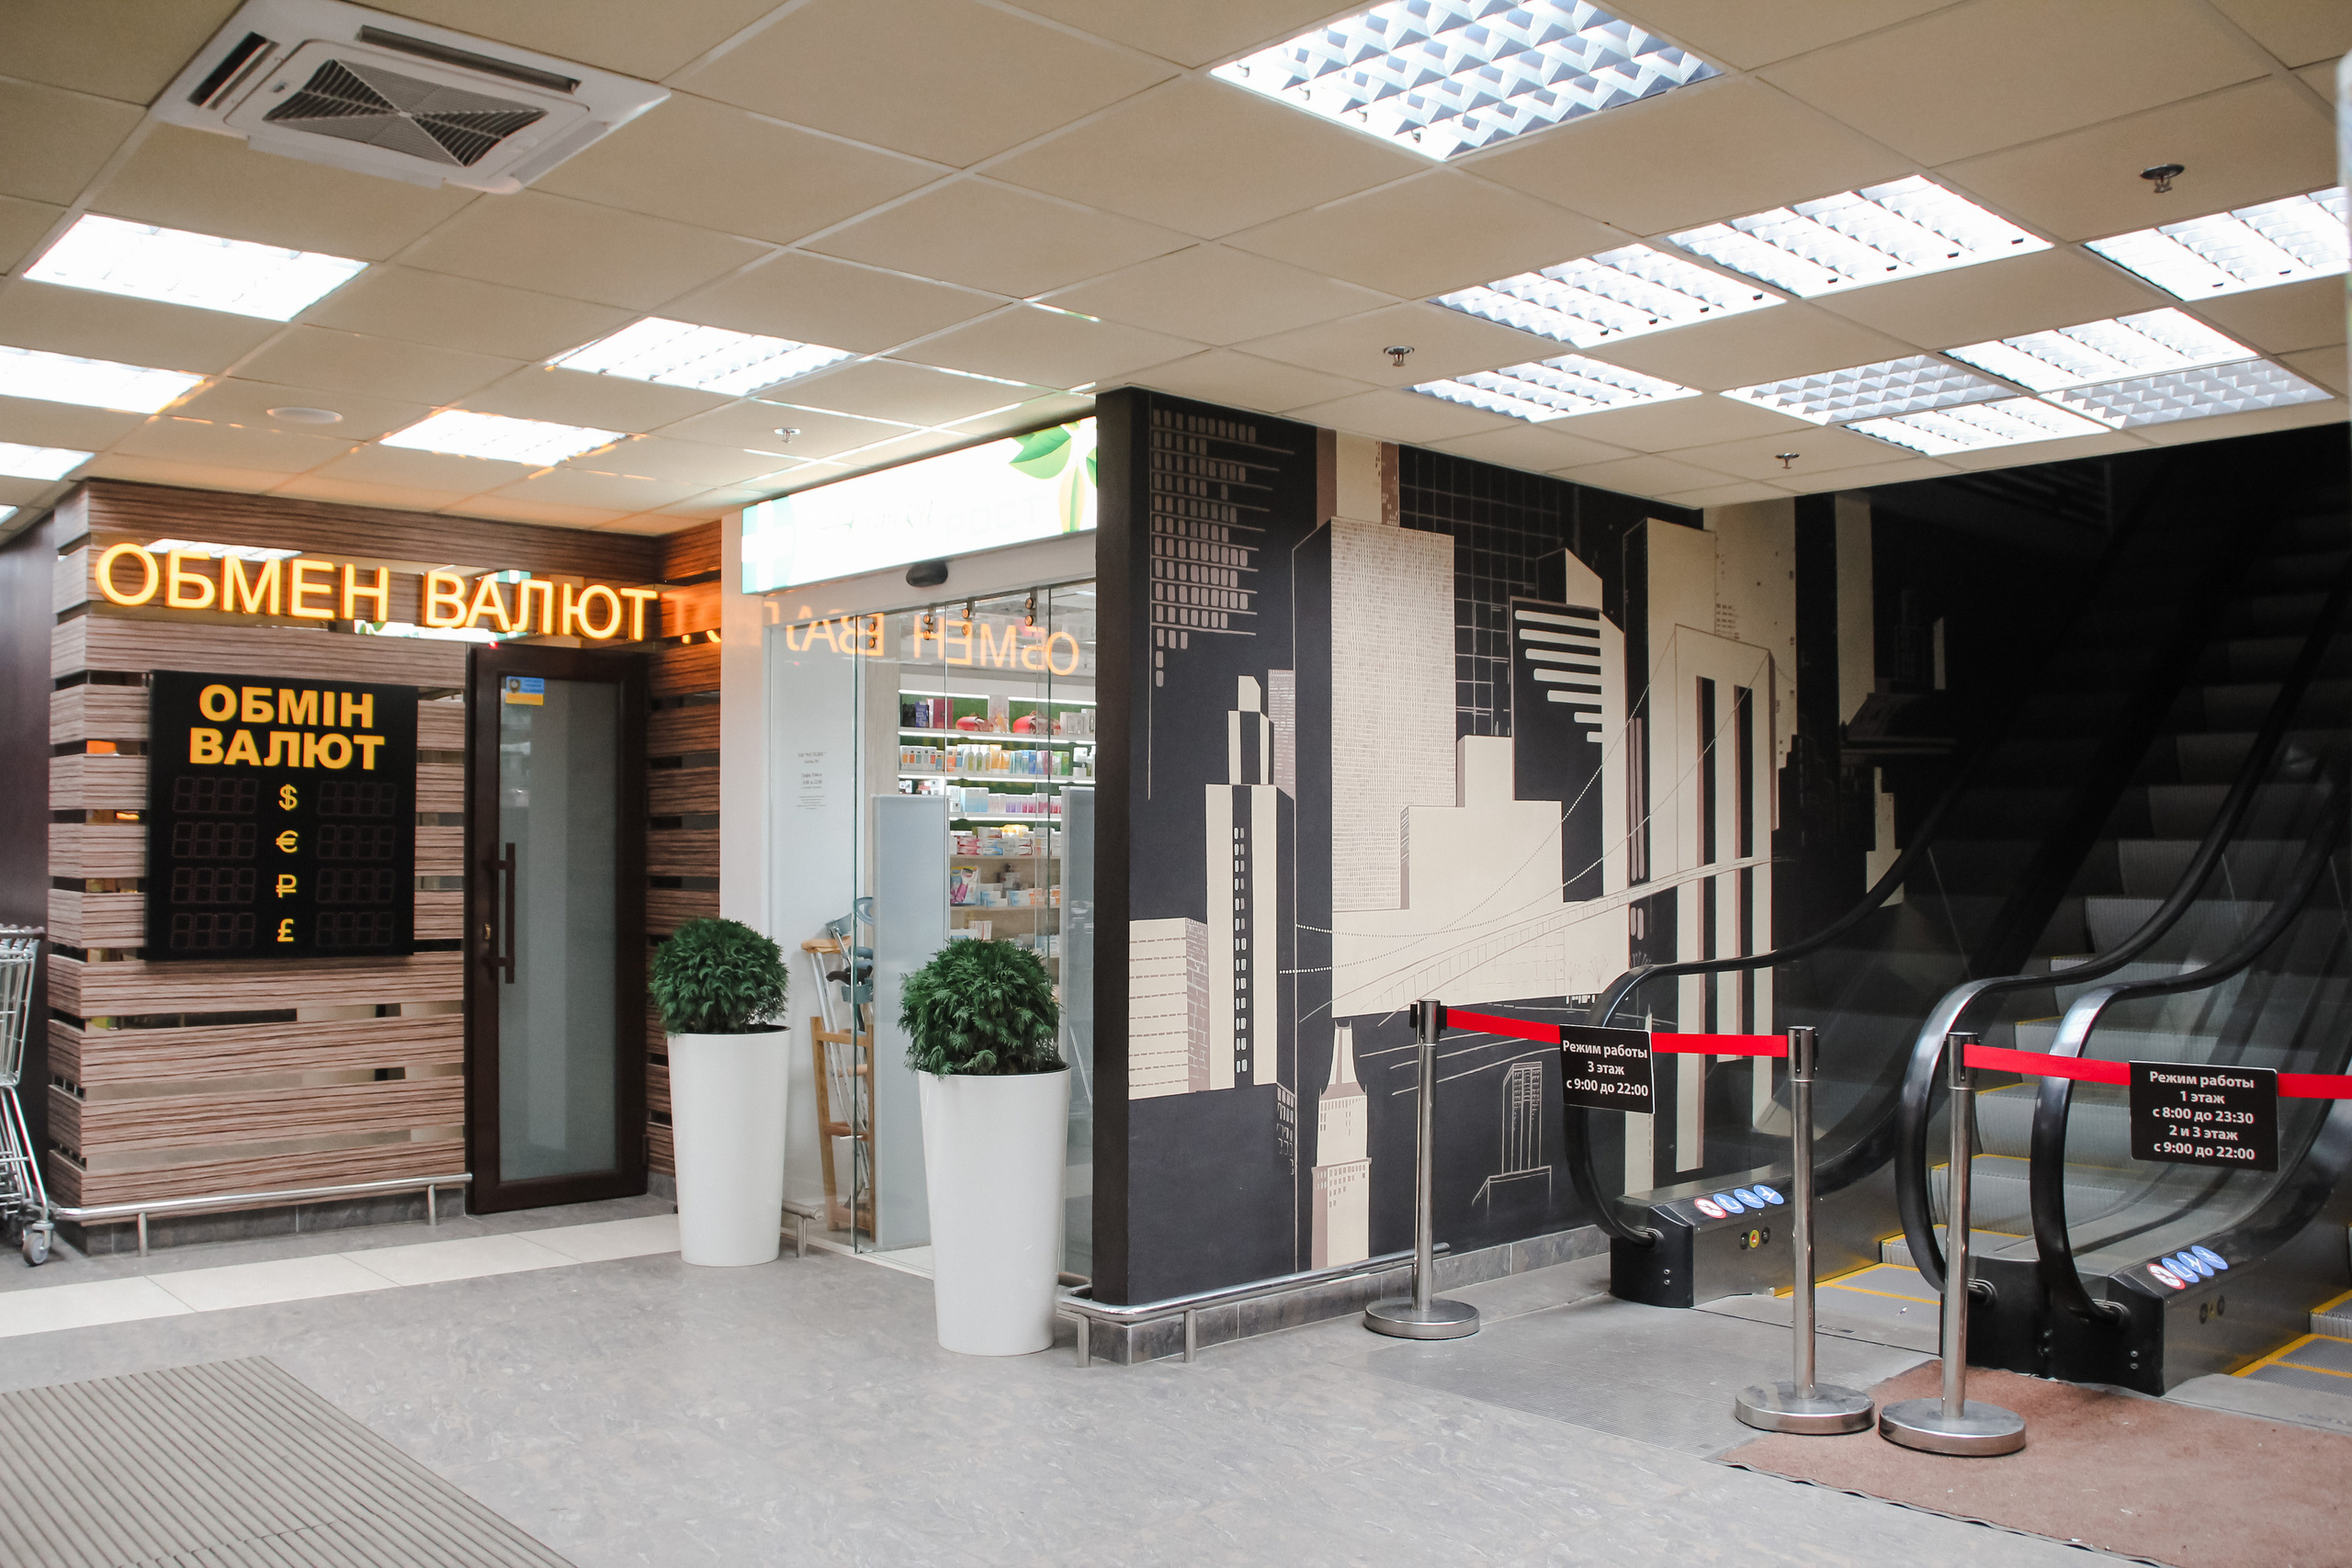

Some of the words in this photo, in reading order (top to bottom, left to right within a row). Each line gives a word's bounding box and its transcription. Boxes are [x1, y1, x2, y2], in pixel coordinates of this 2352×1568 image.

[96, 542, 390, 623] ОБМЕН
[424, 570, 659, 642] ВАЛЮТ
[198, 683, 374, 728] ОБМІН
[189, 727, 385, 770] ВАЛЮТ
[1563, 1040, 1601, 1055] Режим
[1603, 1044, 1648, 1058] работы
[1587, 1061, 1595, 1073] 3
[1596, 1064, 1624, 1076] этаж
[1566, 1079, 1573, 1089] с
[1574, 1078, 1598, 1091] 9:00
[1600, 1084, 1614, 1095] до
[1617, 1082, 1648, 1097] 22:00
[2149, 1071, 2198, 1085] Режим
[2199, 1075, 2255, 1089] работы
[2180, 1090, 2187, 1101] 1
[2190, 1093, 2225, 1104] этаж
[2152, 1108, 2160, 1118] с
[2162, 1107, 2191, 1120] 8:00
[2194, 1111, 2212, 1122] до
[2215, 1111, 2255, 1124] 23:30
[2169, 1124, 2177, 1136] 2
[2180, 1128, 2189, 1136] и
[2192, 1126, 2200, 1138] 3
[2203, 1129, 2238, 1141] этаж
[2154, 1143, 2161, 1152] с
[2163, 1142, 2193, 1155] 9:00
[2195, 1145, 2213, 1157] до
[2216, 1145, 2256, 1160] 22:00
